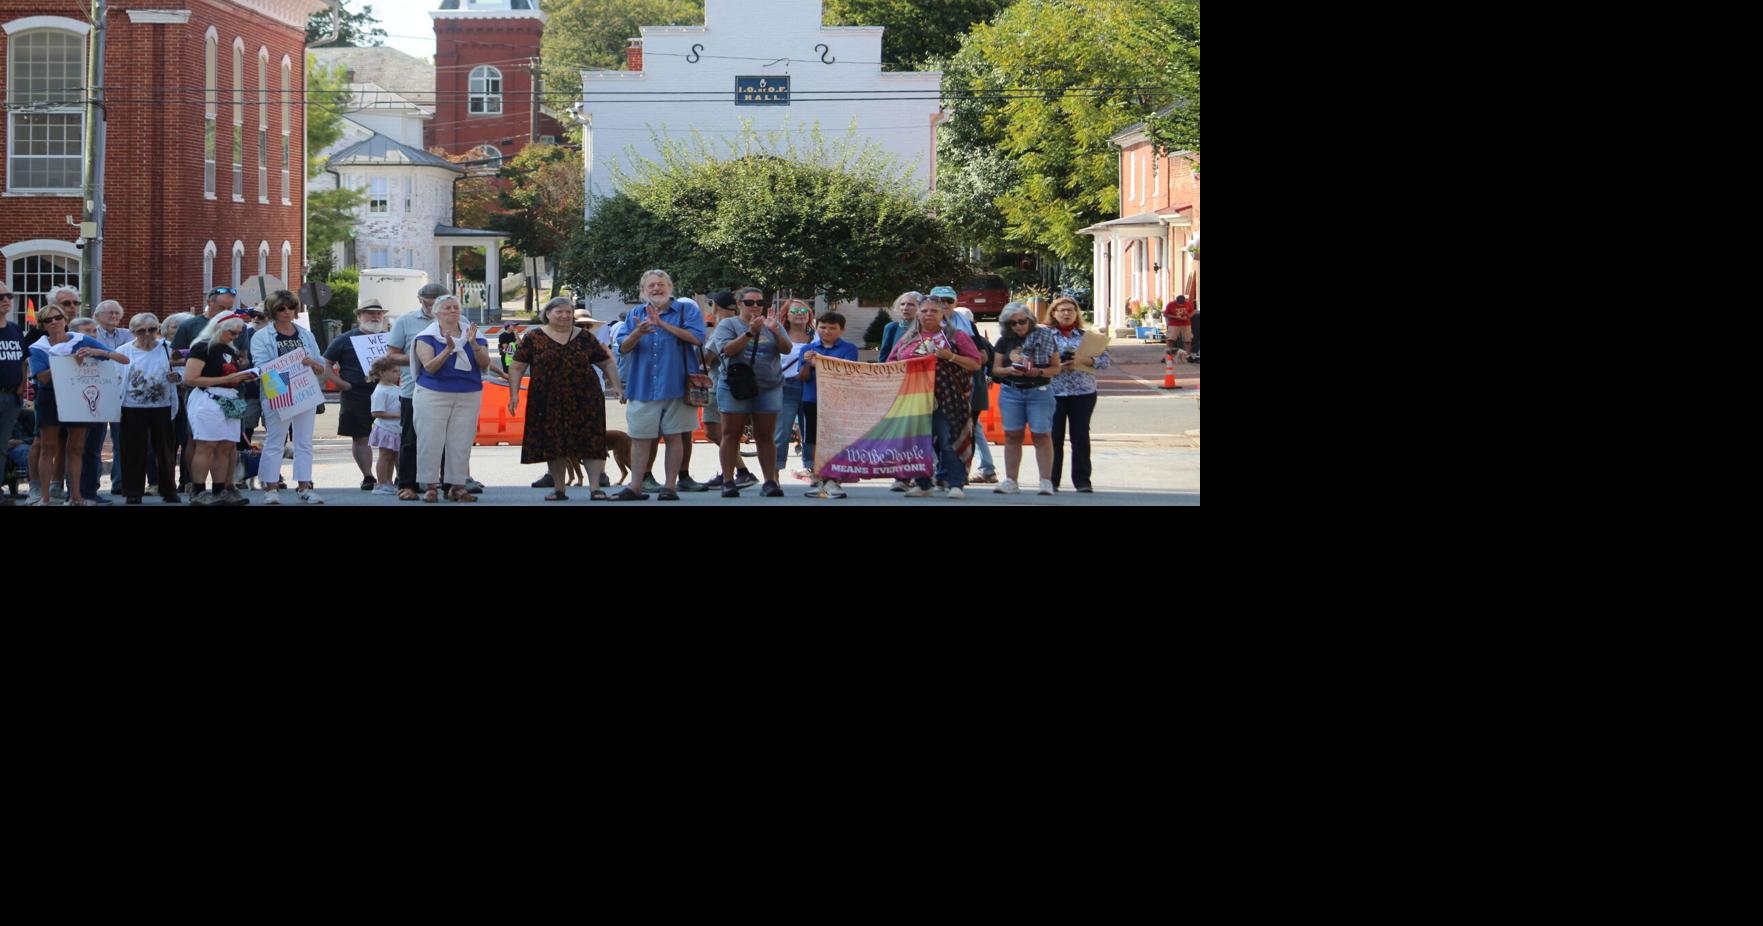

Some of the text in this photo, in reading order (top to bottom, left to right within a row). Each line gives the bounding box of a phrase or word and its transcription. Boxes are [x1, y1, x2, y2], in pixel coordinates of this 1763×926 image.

[277, 340, 303, 349] RESIS
[368, 334, 387, 344] WE
[821, 359, 841, 372] We
[863, 363, 907, 378] People
[847, 448, 865, 464] We
[884, 444, 924, 464] People
[831, 463, 927, 475] MEANS EVERYONE
